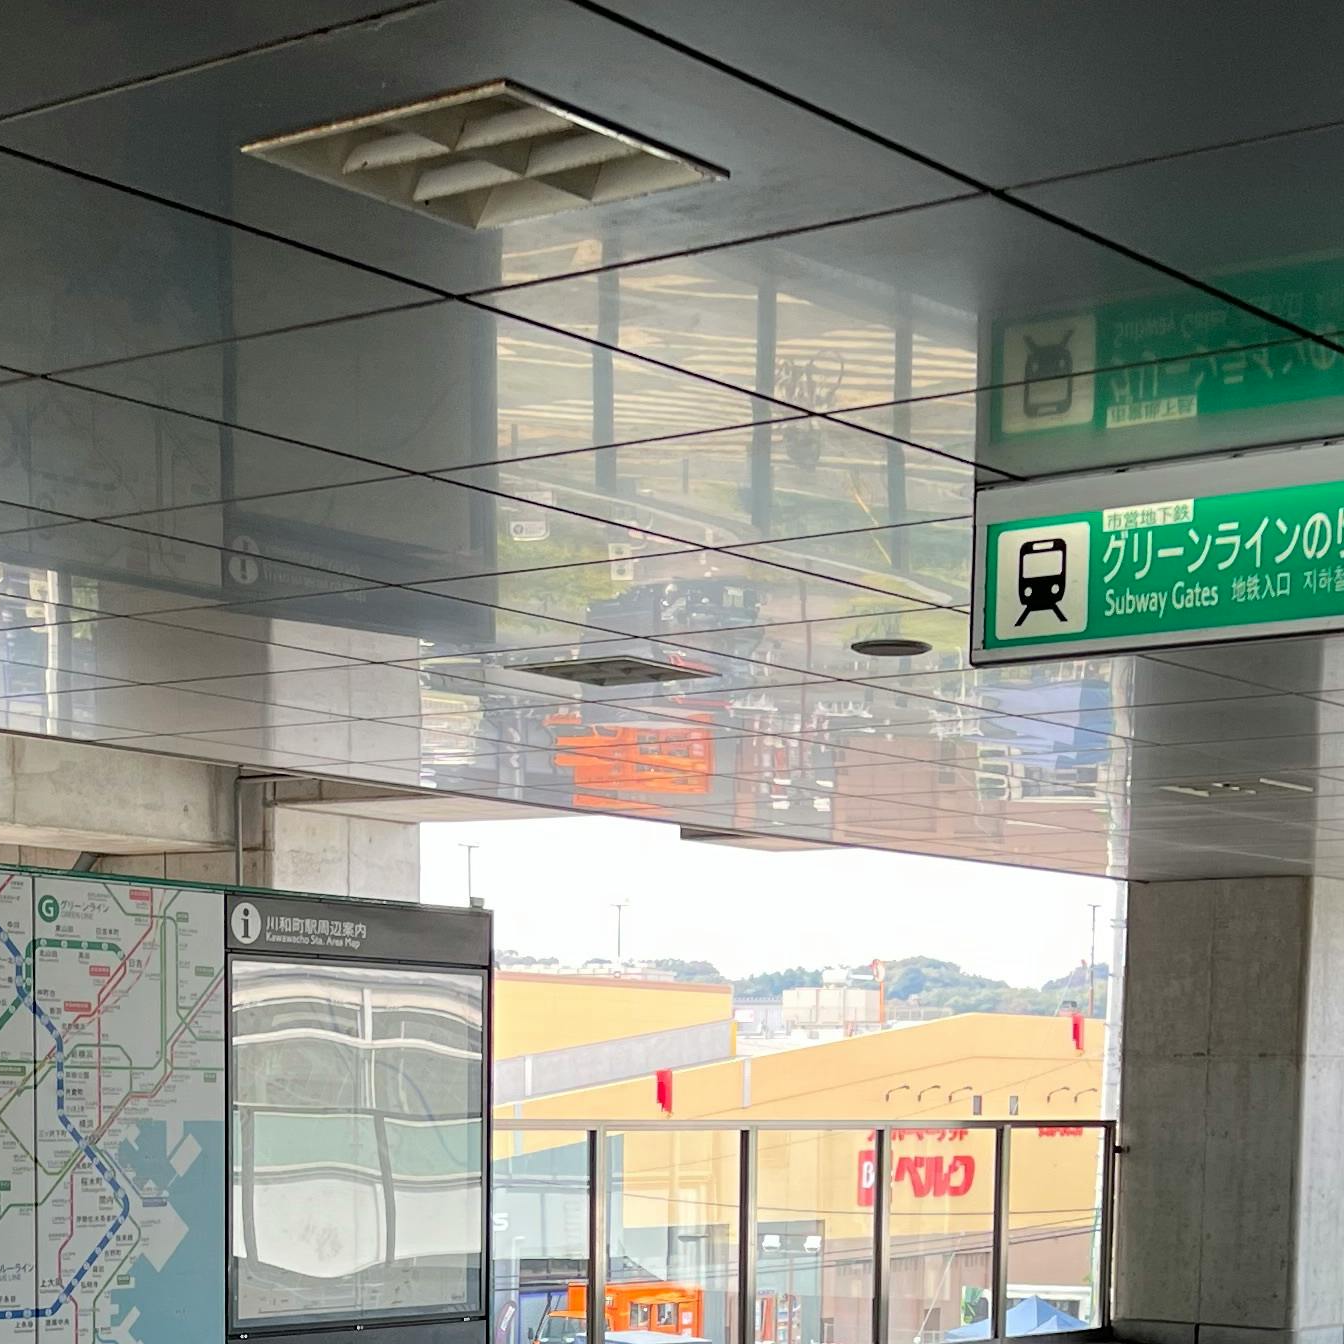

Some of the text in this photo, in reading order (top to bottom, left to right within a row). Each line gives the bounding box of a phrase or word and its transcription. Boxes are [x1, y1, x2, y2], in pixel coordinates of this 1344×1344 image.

[1106, 503, 1191, 530] 市営地下鉄
[1104, 580, 1219, 618] Subway Gates
[1231, 571, 1291, 603] 地铁入口
[60, 899, 110, 913] グリーンライン
[265, 915, 367, 939] 川和町駅周辺案内
[265, 931, 361, 950] Kawawacho Sta. Area Map
[894, 1155, 976, 1199] ベルク
